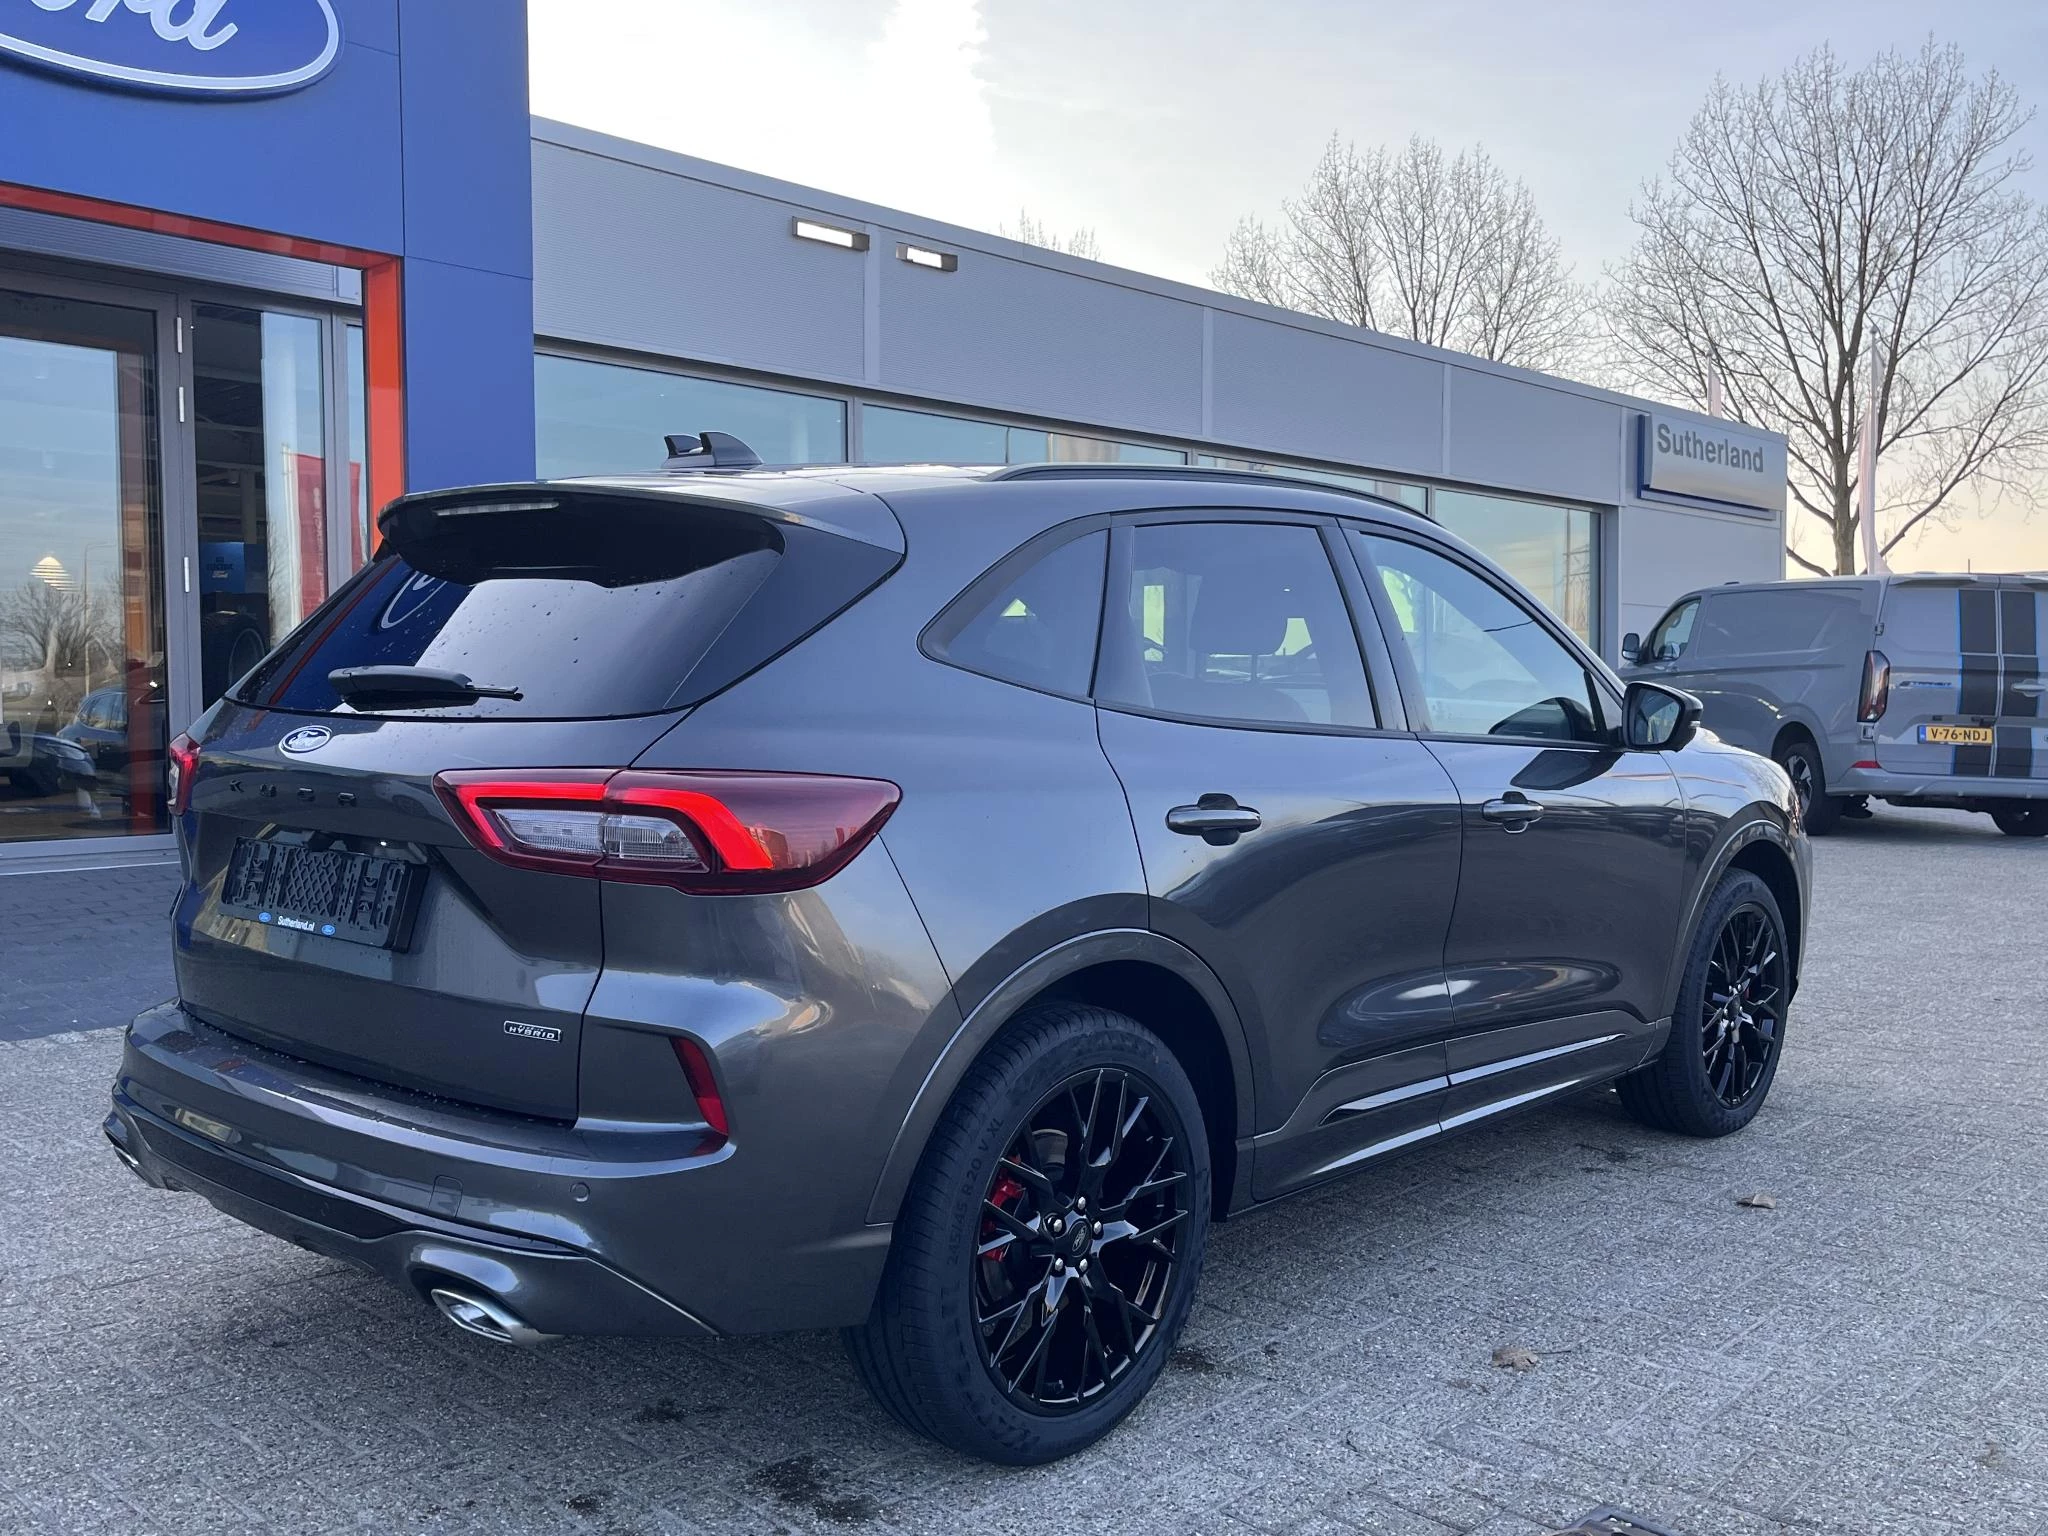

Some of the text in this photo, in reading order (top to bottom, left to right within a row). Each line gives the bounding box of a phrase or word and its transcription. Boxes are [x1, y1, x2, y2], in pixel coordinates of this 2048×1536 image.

[1657, 423, 1764, 473] Sutherland
[1930, 728, 1988, 741] V-76-NDJ
[277, 915, 316, 932] Sutherland.nl
[509, 1026, 555, 1039] HYBRID
[946, 1117, 1005, 1266] 245/45 R 20 V XL
